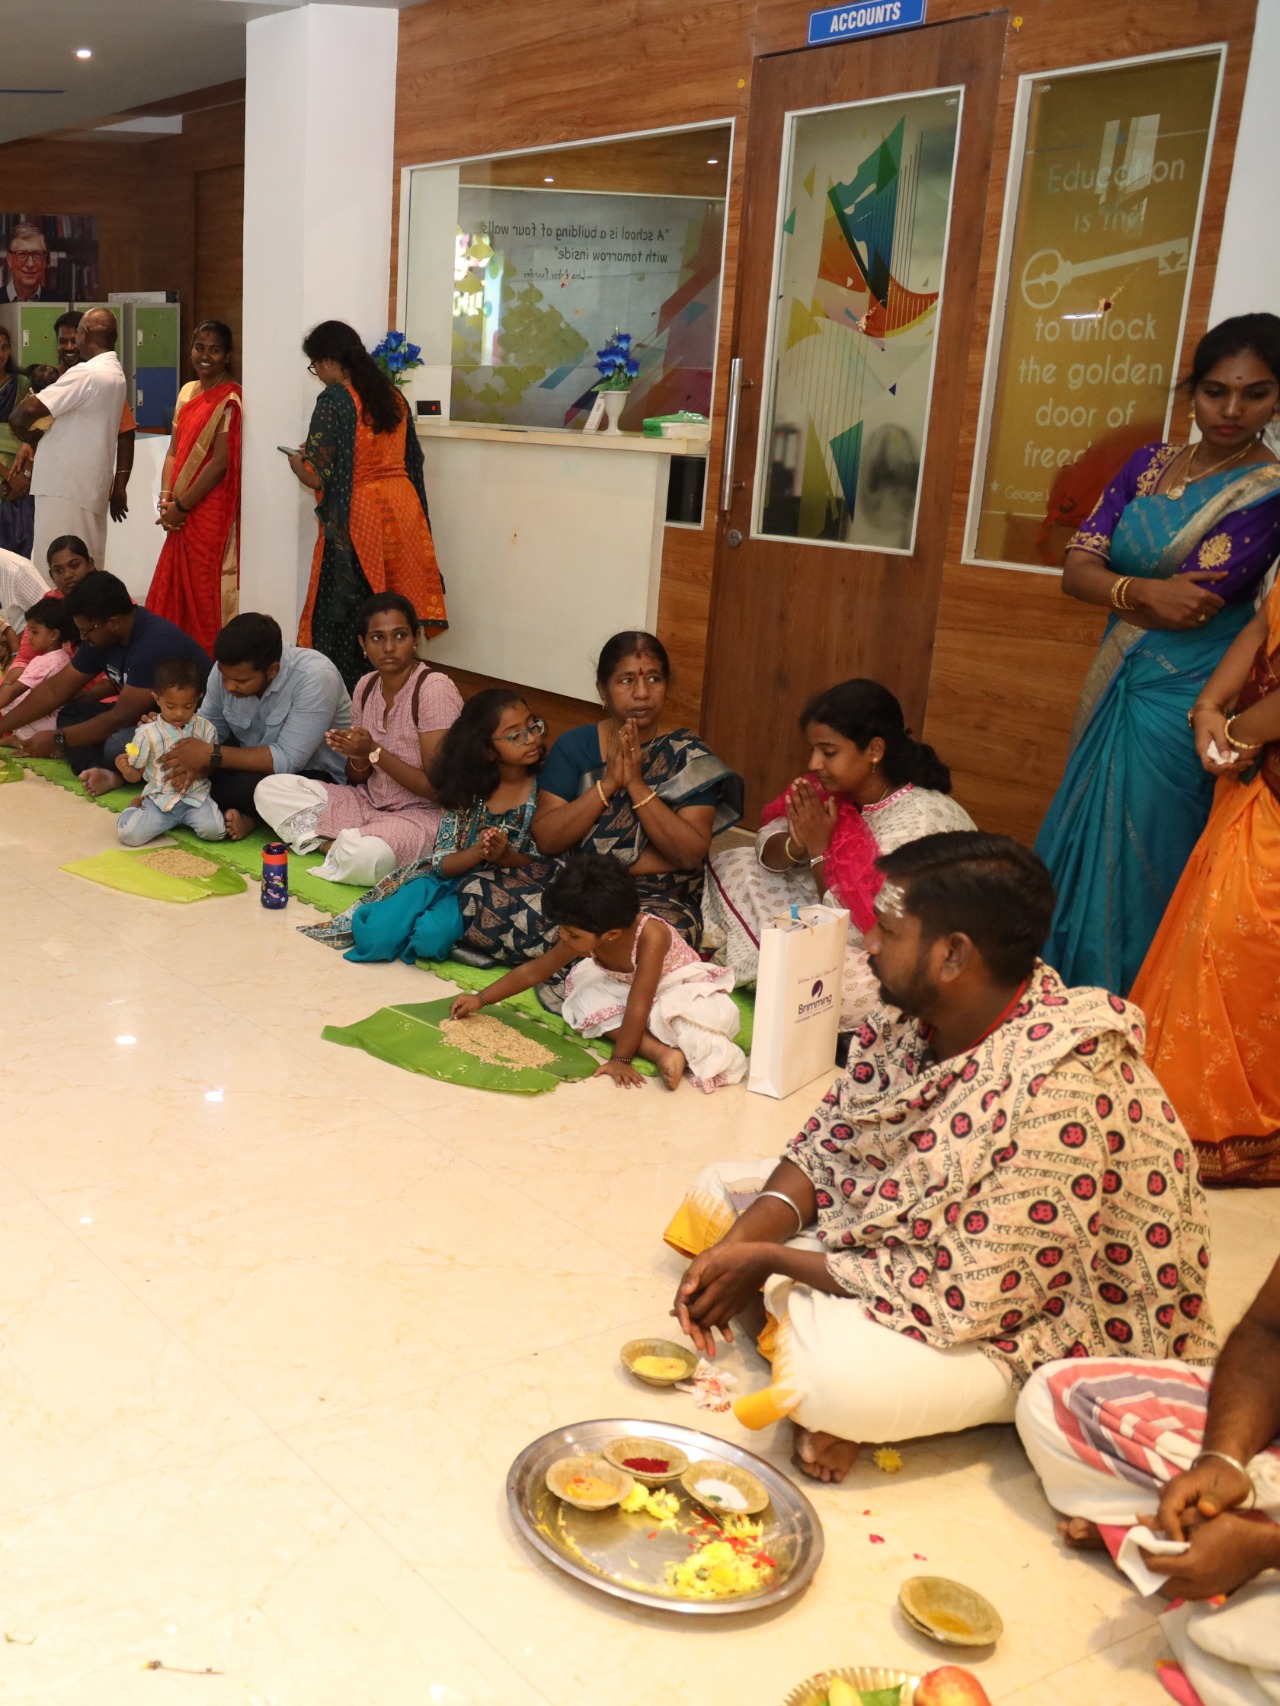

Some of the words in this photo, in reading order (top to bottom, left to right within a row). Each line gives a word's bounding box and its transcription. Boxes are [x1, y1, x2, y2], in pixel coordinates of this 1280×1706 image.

[829, 1, 902, 33] ACCOUNTS
[1073, 207, 1092, 233] is
[1035, 315, 1061, 342] to
[1070, 312, 1157, 342] unlock
[1019, 355, 1057, 385] the
[1067, 354, 1163, 390] golden
[1035, 397, 1098, 428] door
[1107, 400, 1137, 429] of
[798, 993, 833, 1015] Brimming
